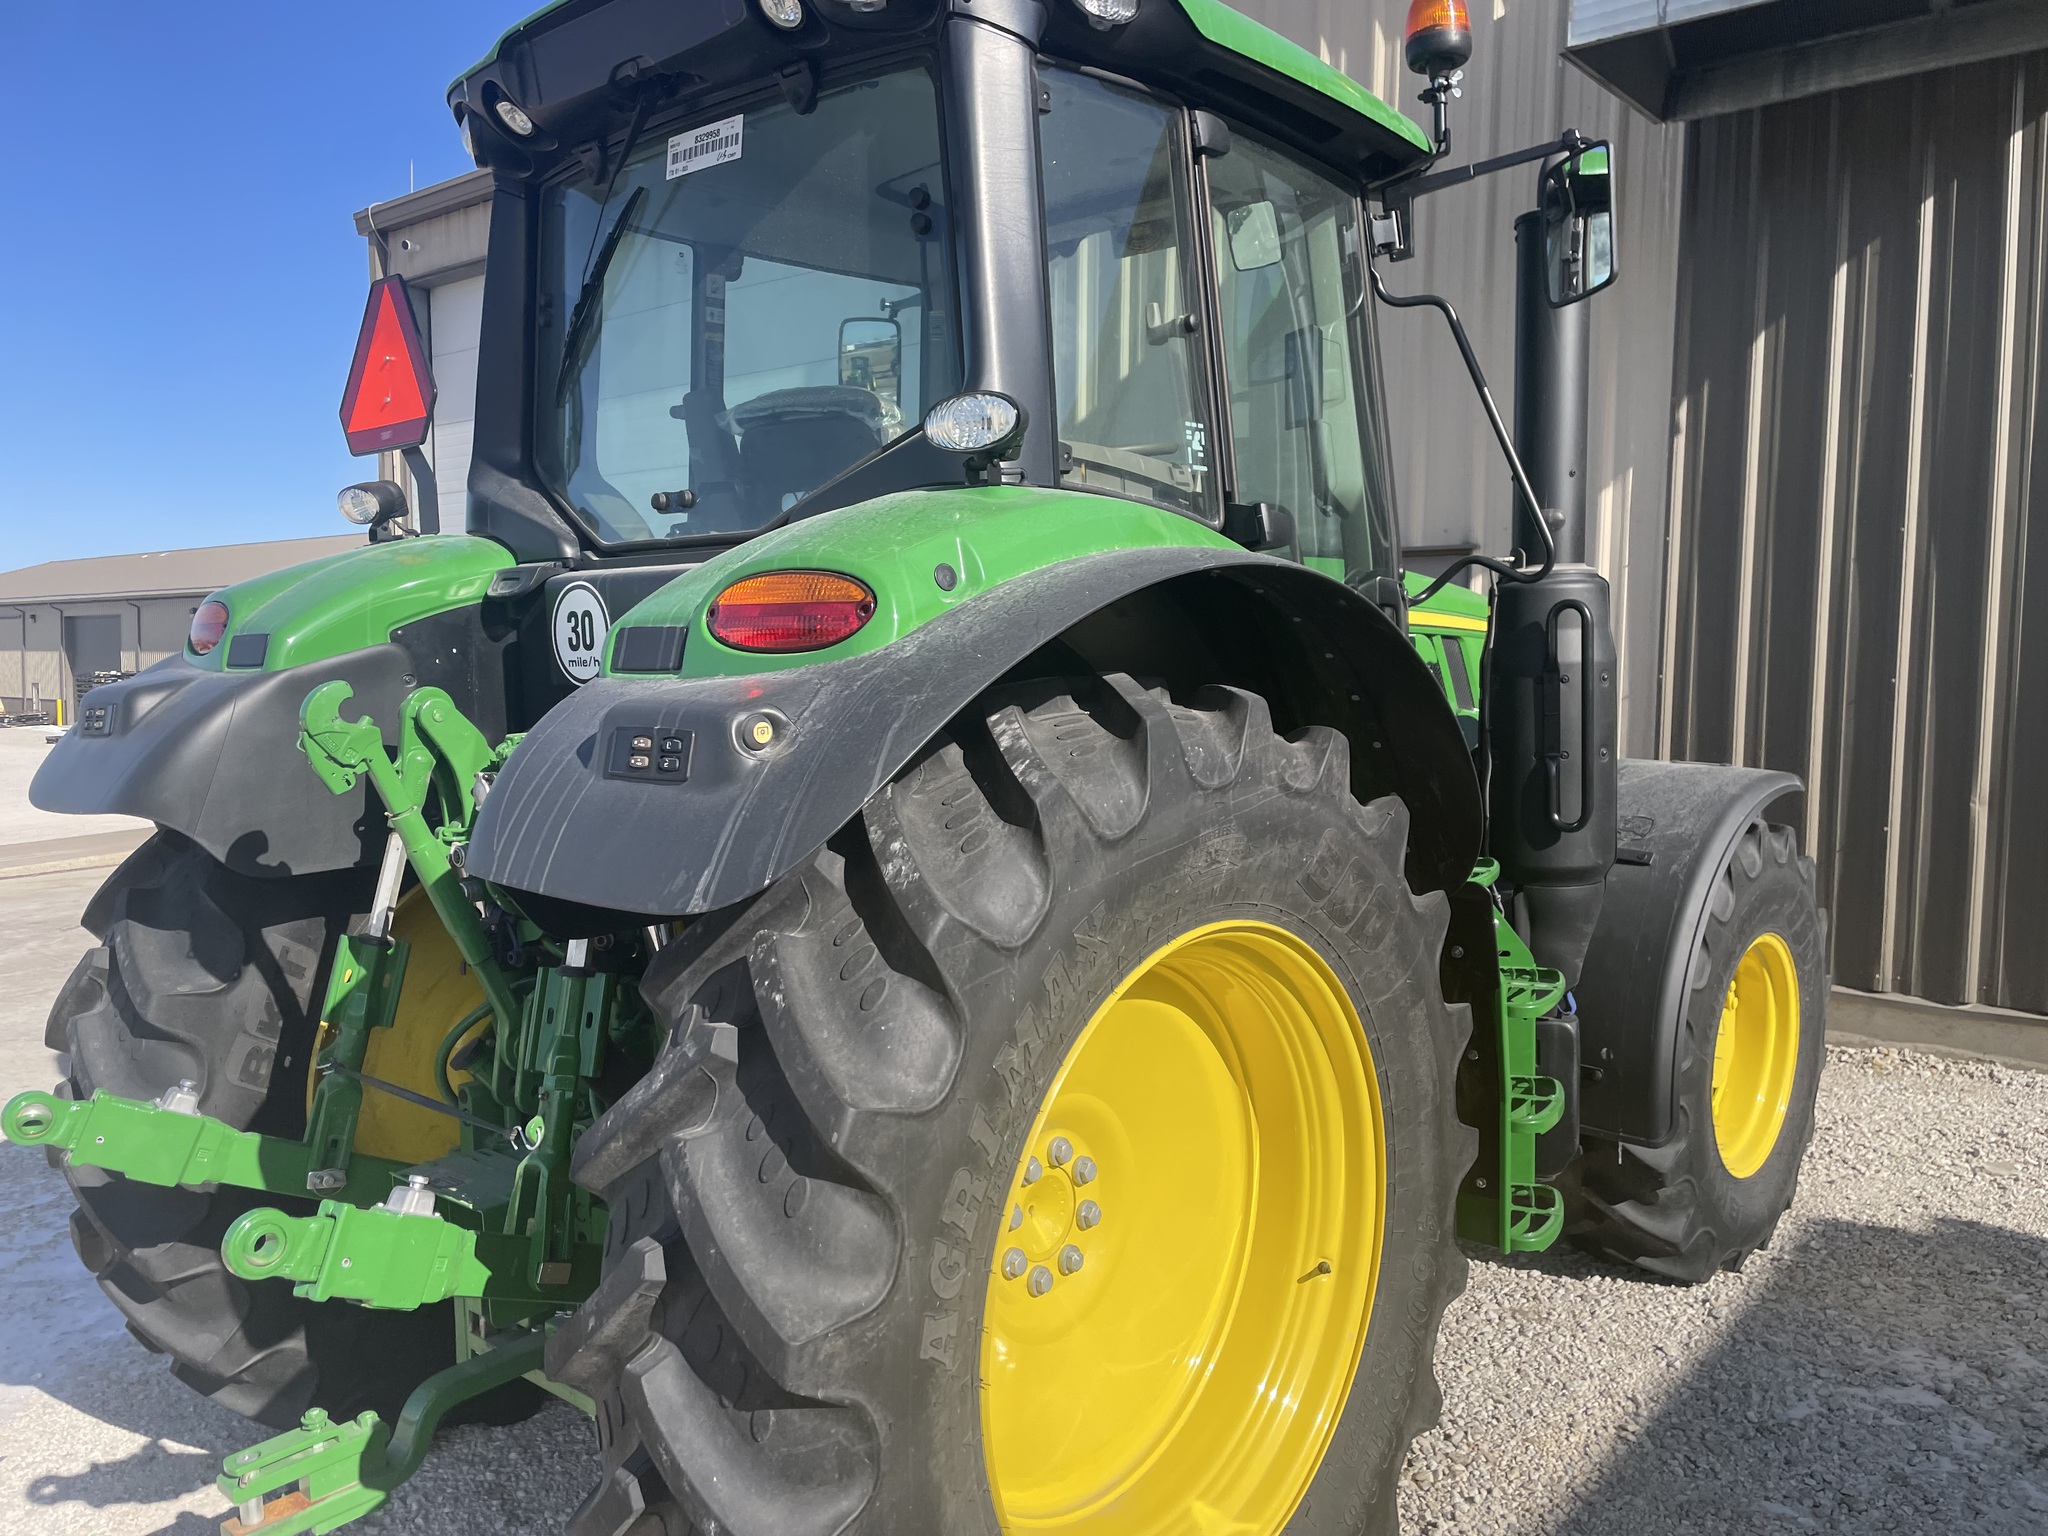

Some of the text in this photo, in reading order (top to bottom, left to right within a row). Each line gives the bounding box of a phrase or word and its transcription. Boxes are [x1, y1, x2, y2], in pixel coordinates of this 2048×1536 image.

[694, 128, 721, 144] 8329958
[566, 609, 595, 652] 30
[568, 655, 601, 668] mile/h
